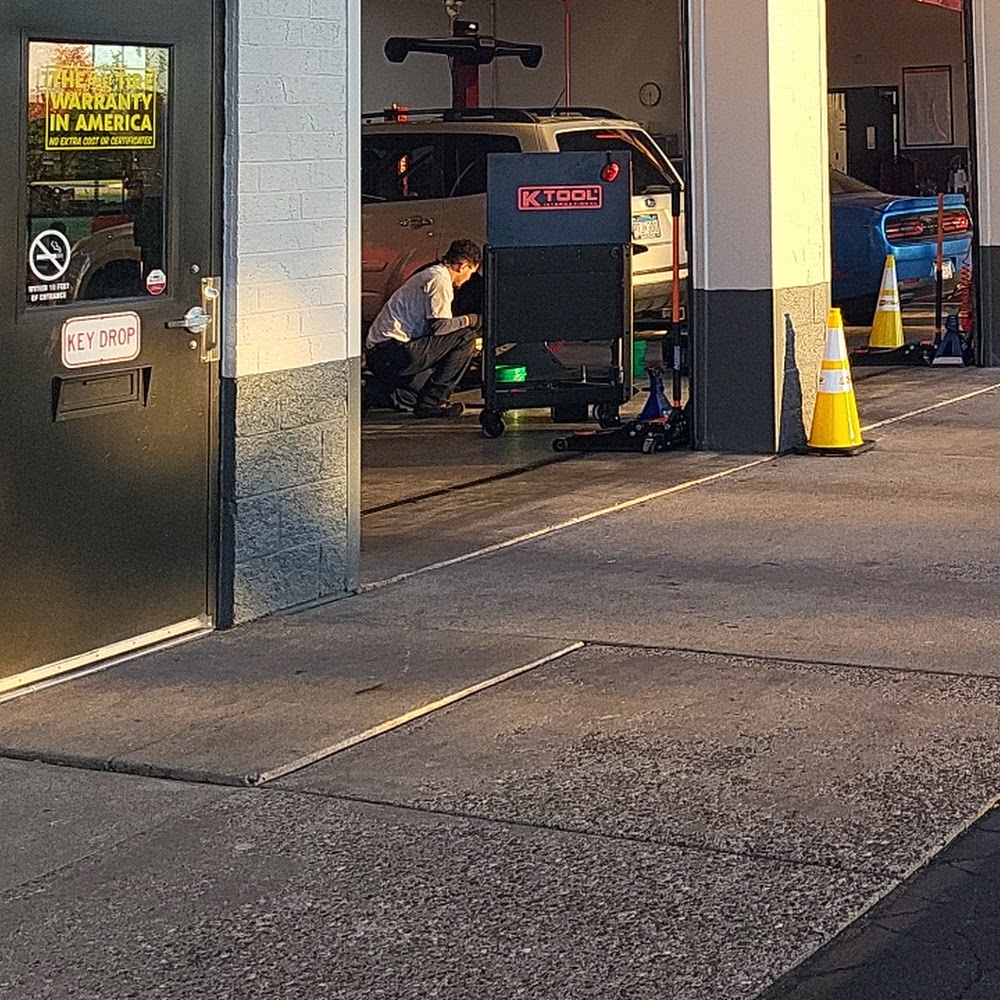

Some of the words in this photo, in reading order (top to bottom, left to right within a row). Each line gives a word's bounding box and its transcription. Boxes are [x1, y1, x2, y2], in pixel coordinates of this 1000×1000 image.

[50, 92, 153, 110] WARRANTY
[50, 113, 70, 131] IN
[75, 113, 152, 131] AMERICA
[49, 137, 59, 146] NO
[60, 136, 81, 146] EXTRA
[83, 136, 100, 145] COST
[522, 190, 541, 207] K
[543, 189, 598, 202] TOOL
[68, 330, 95, 352] KEY
[99, 327, 135, 348] DROP
